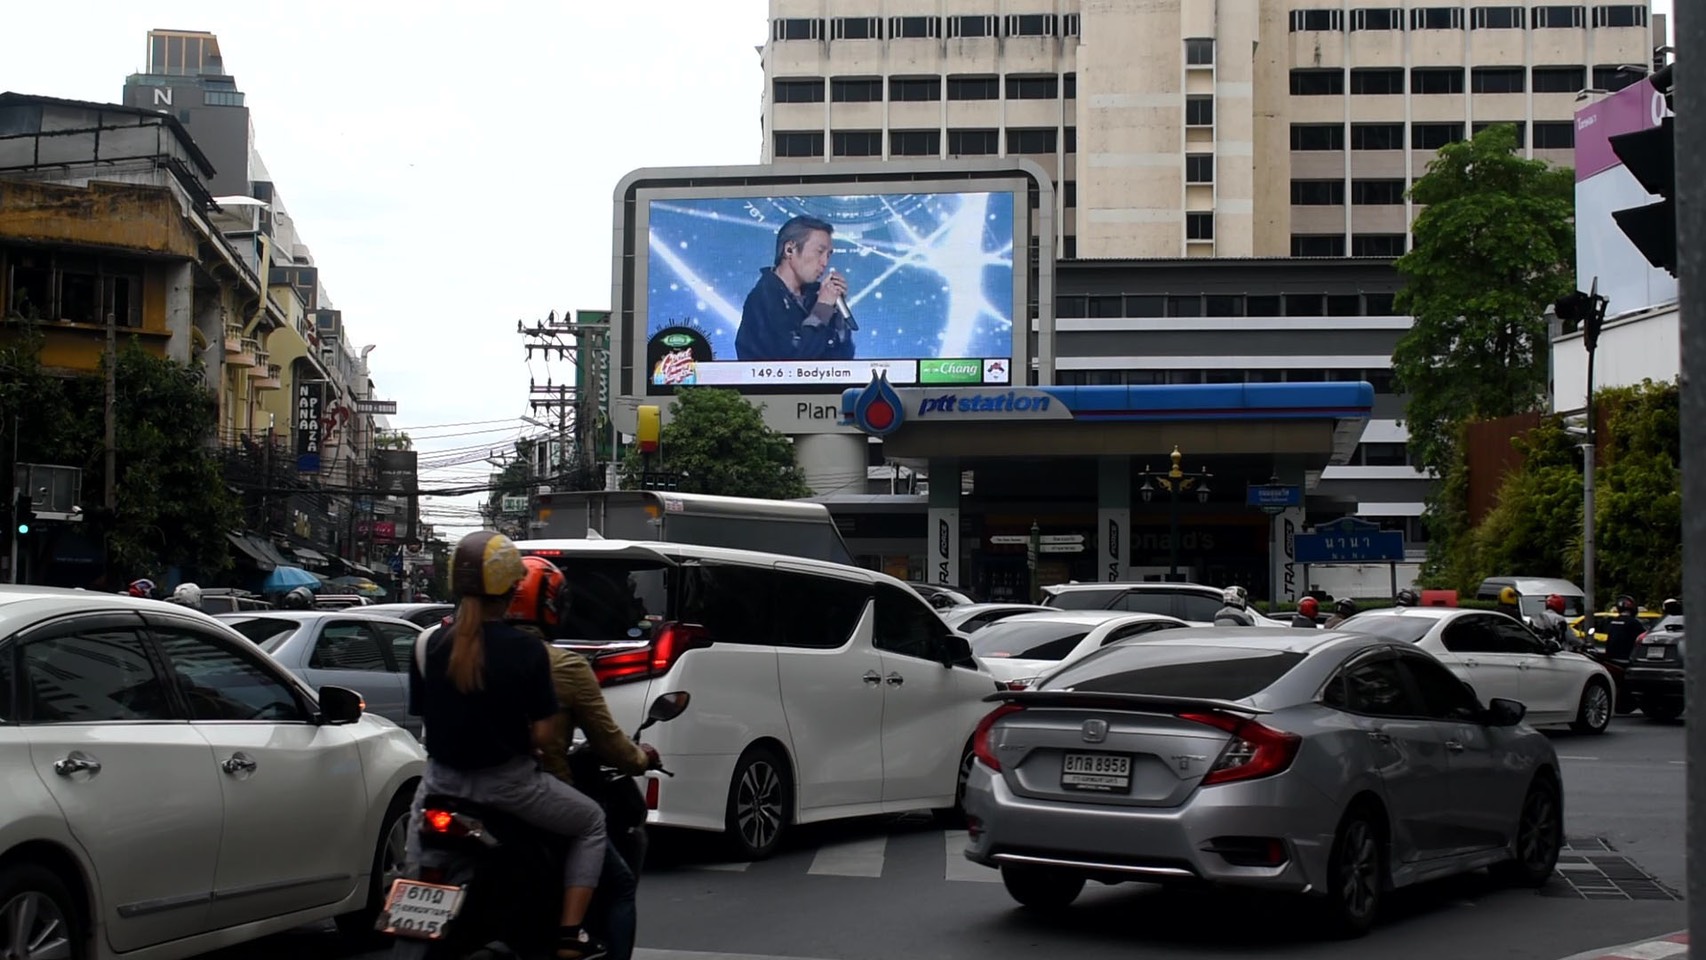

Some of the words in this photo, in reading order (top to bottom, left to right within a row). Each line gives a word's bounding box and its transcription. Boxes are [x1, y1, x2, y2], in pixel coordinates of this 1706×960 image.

[751, 367, 784, 378] 149.6
[796, 366, 851, 380] Bodyslam
[940, 362, 978, 375] Chang
[797, 401, 836, 419] Plan
[918, 394, 956, 416] ptt
[958, 391, 1050, 413] station
[299, 385, 309, 430] NANA
[307, 397, 319, 452] PLAZA
[940, 523, 948, 556] FORCE
[1324, 536, 1370, 549] นานา
[939, 562, 949, 584] RA
[1284, 562, 1295, 603] LTRA
[1095, 757, 1127, 773] 8958
[392, 917, 440, 934] 4015
